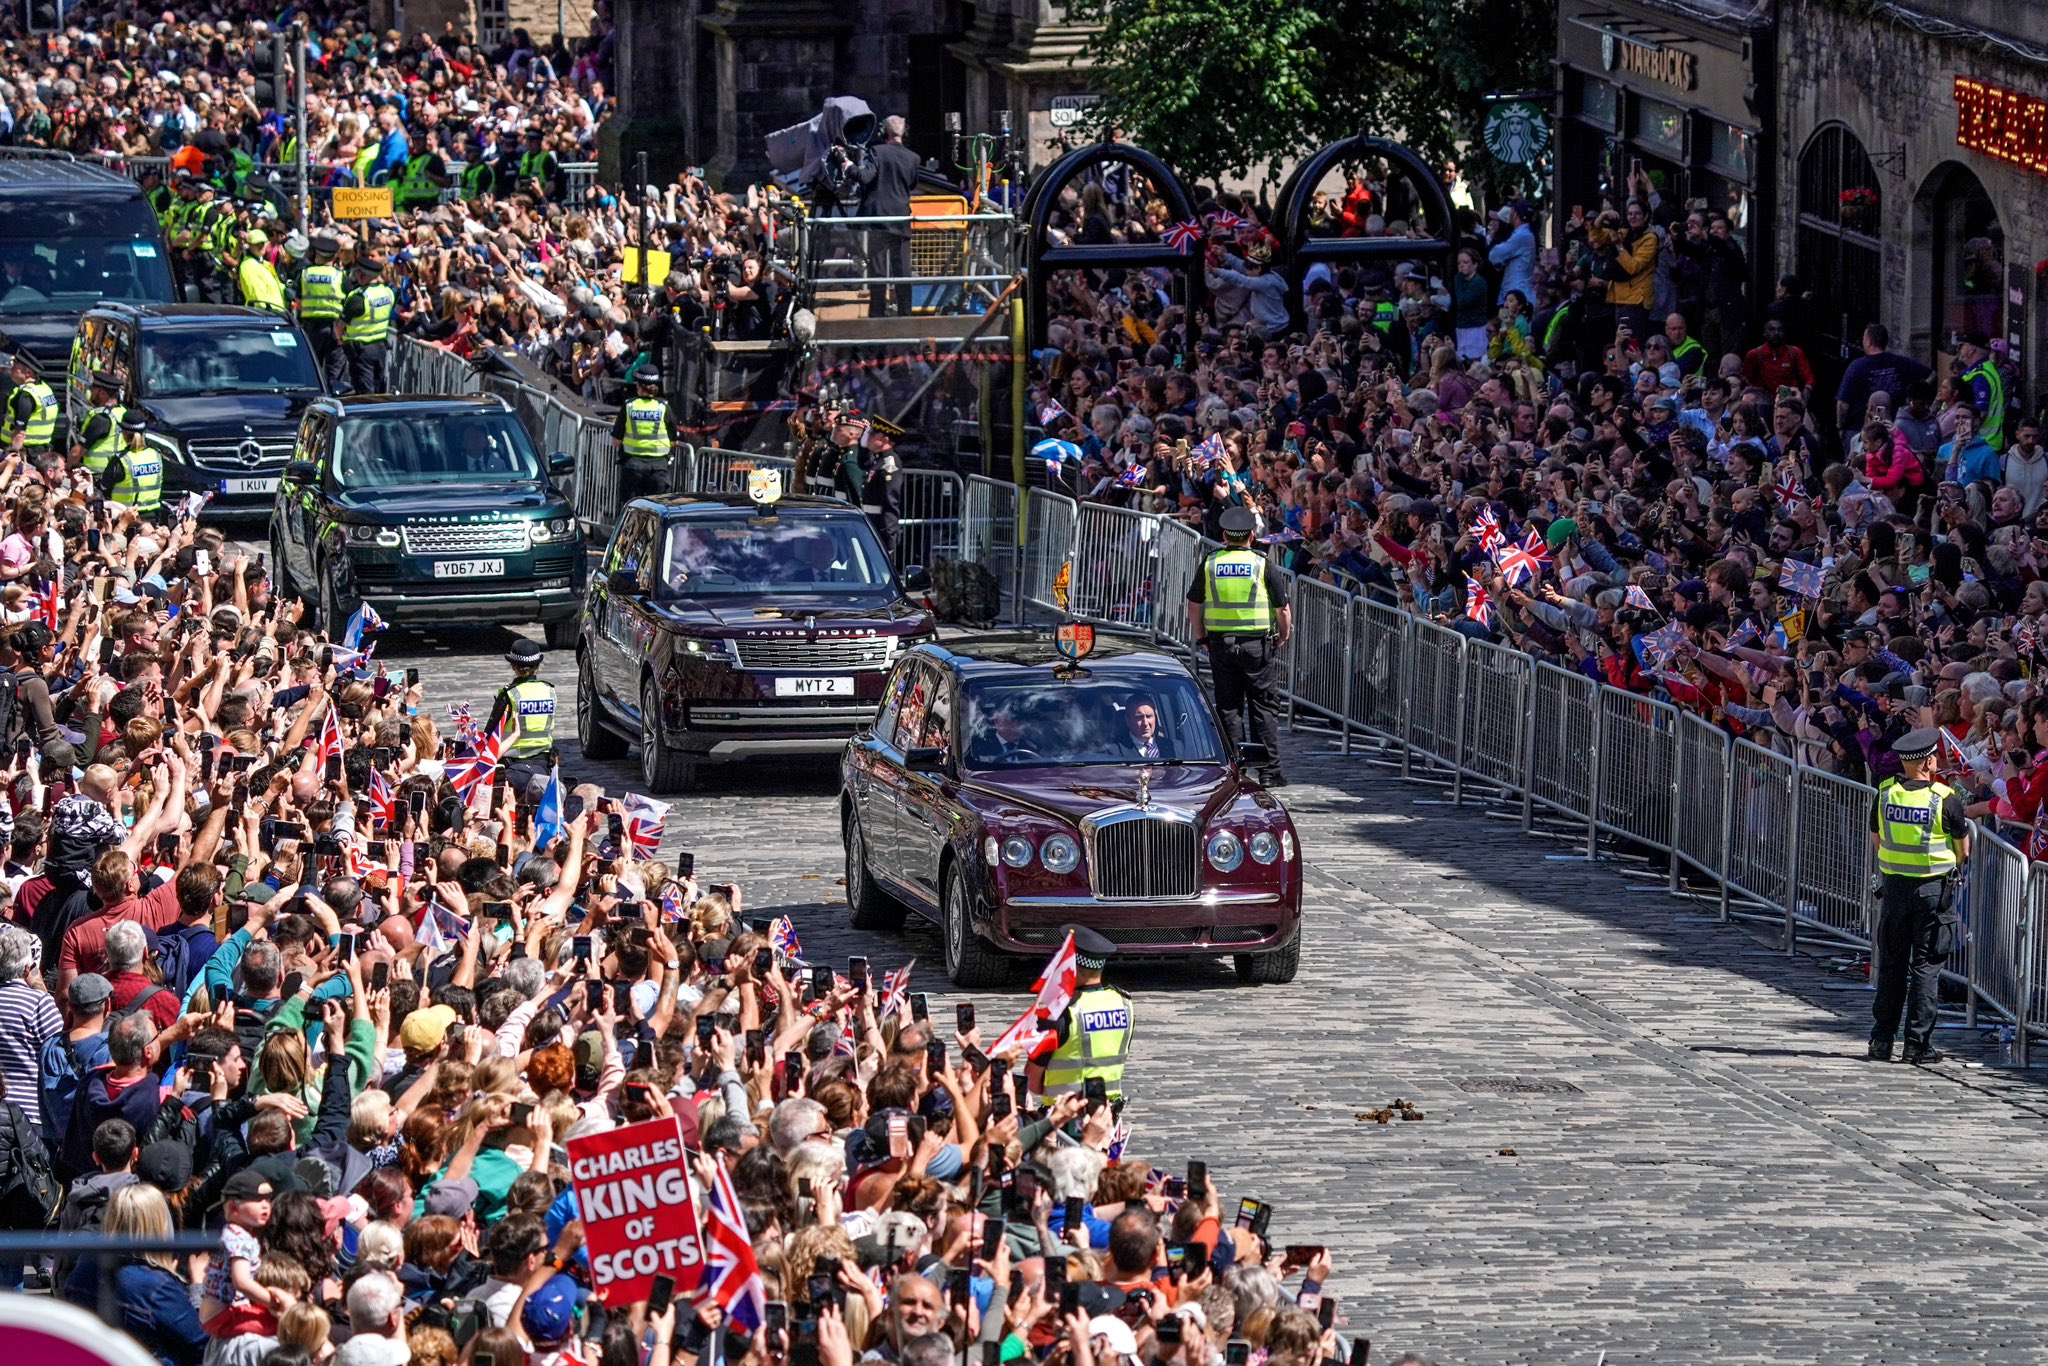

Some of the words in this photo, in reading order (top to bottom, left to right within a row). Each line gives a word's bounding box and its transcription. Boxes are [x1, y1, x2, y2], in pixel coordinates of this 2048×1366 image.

[1621, 40, 1691, 91] STARBUCKS
[334, 191, 389, 202] CROSSING
[346, 206, 378, 216] POINT
[632, 410, 660, 420] POLICE
[134, 463, 160, 476] POLICE
[246, 480, 267, 491] KUV
[470, 512, 521, 521] ROVER
[443, 562, 475, 575] YD67
[478, 561, 502, 573] JXJ
[1217, 564, 1251, 576] POLICE
[818, 628, 877, 636] ROVER
[795, 680, 822, 692] MYT
[826, 680, 835, 691] 2
[520, 701, 553, 713] POLICE
[1886, 806, 1928, 823] POLICE
[1084, 1010, 1127, 1030] POLICE
[573, 1138, 681, 1181] CHARLES
[580, 1167, 688, 1224] KING
[624, 1216, 655, 1241] OF
[593, 1235, 700, 1285] SCOTS
